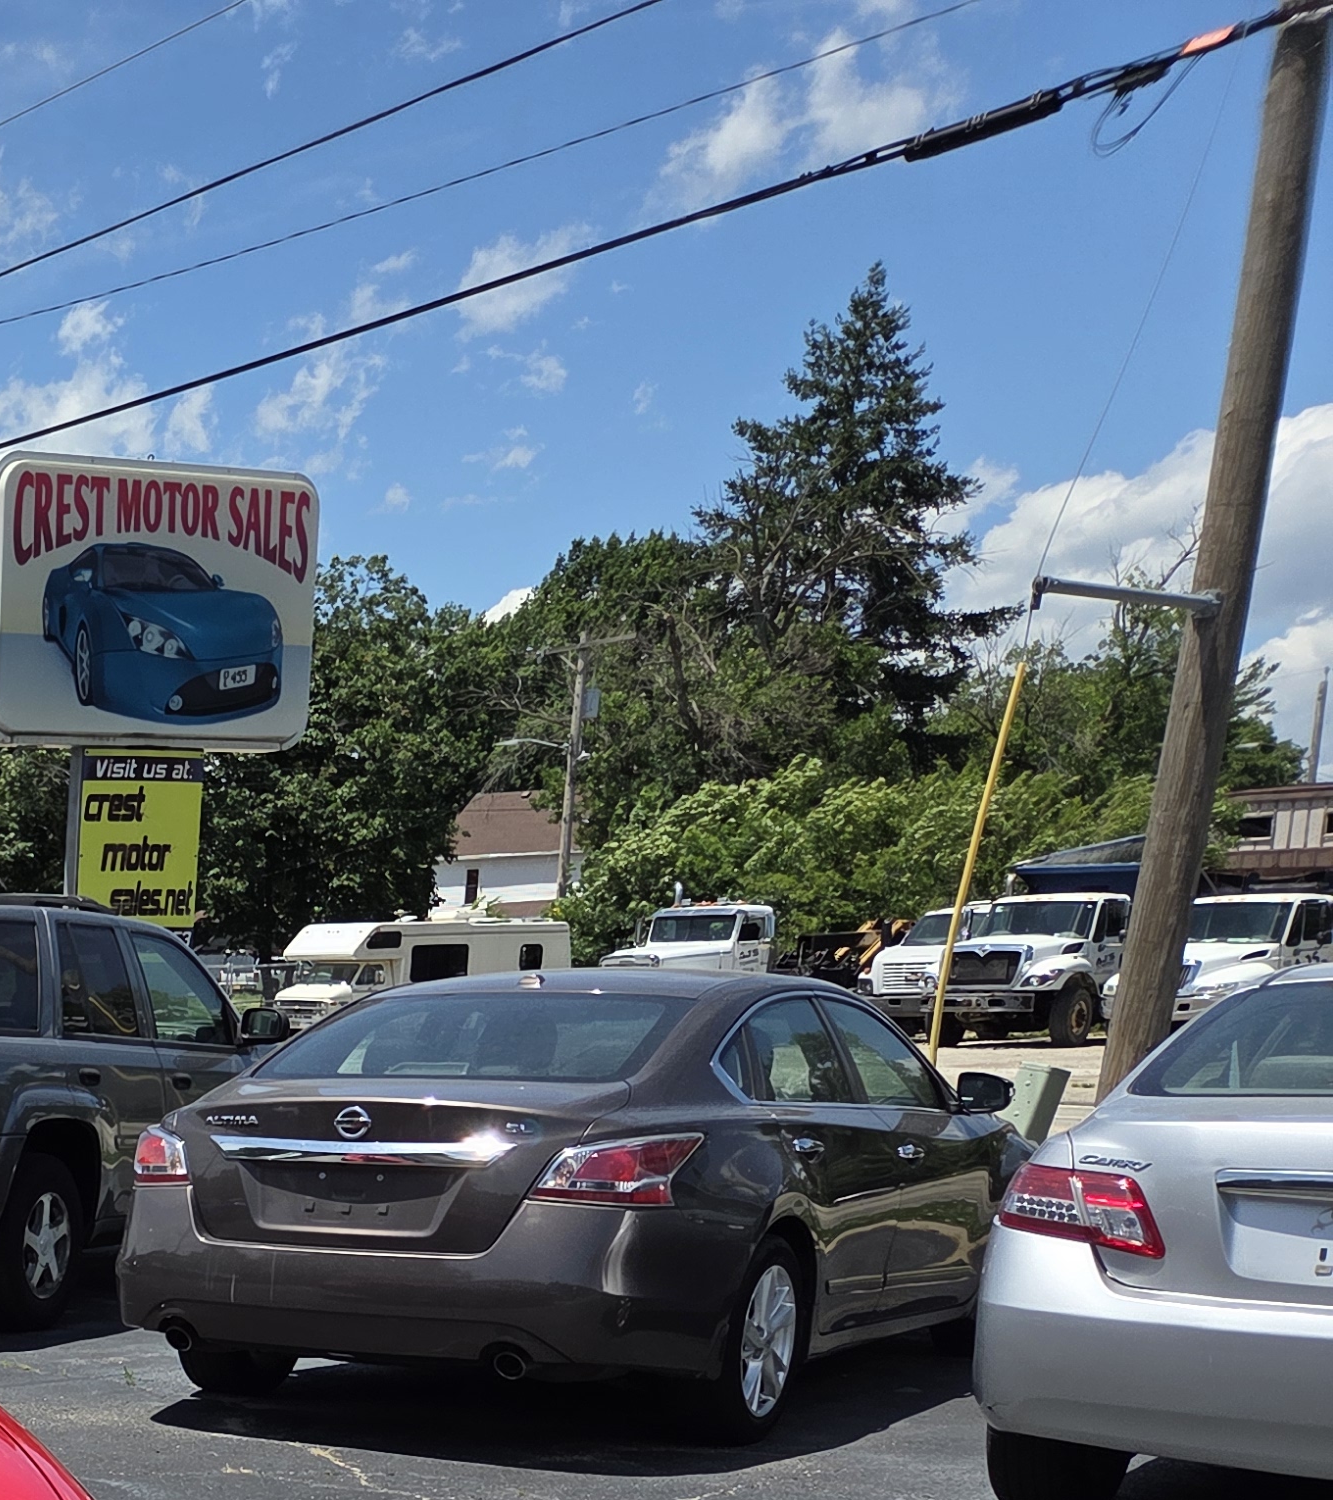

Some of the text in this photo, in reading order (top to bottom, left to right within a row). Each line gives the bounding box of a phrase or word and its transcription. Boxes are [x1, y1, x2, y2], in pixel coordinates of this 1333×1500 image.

[13, 470, 311, 584] CREST MOTOR SALES
[96, 759, 193, 779] Visit us at:
[84, 785, 146, 822] crest
[100, 835, 171, 872] motor
[109, 880, 193, 916] sales.net
[205, 1115, 259, 1126] ALTIMA
